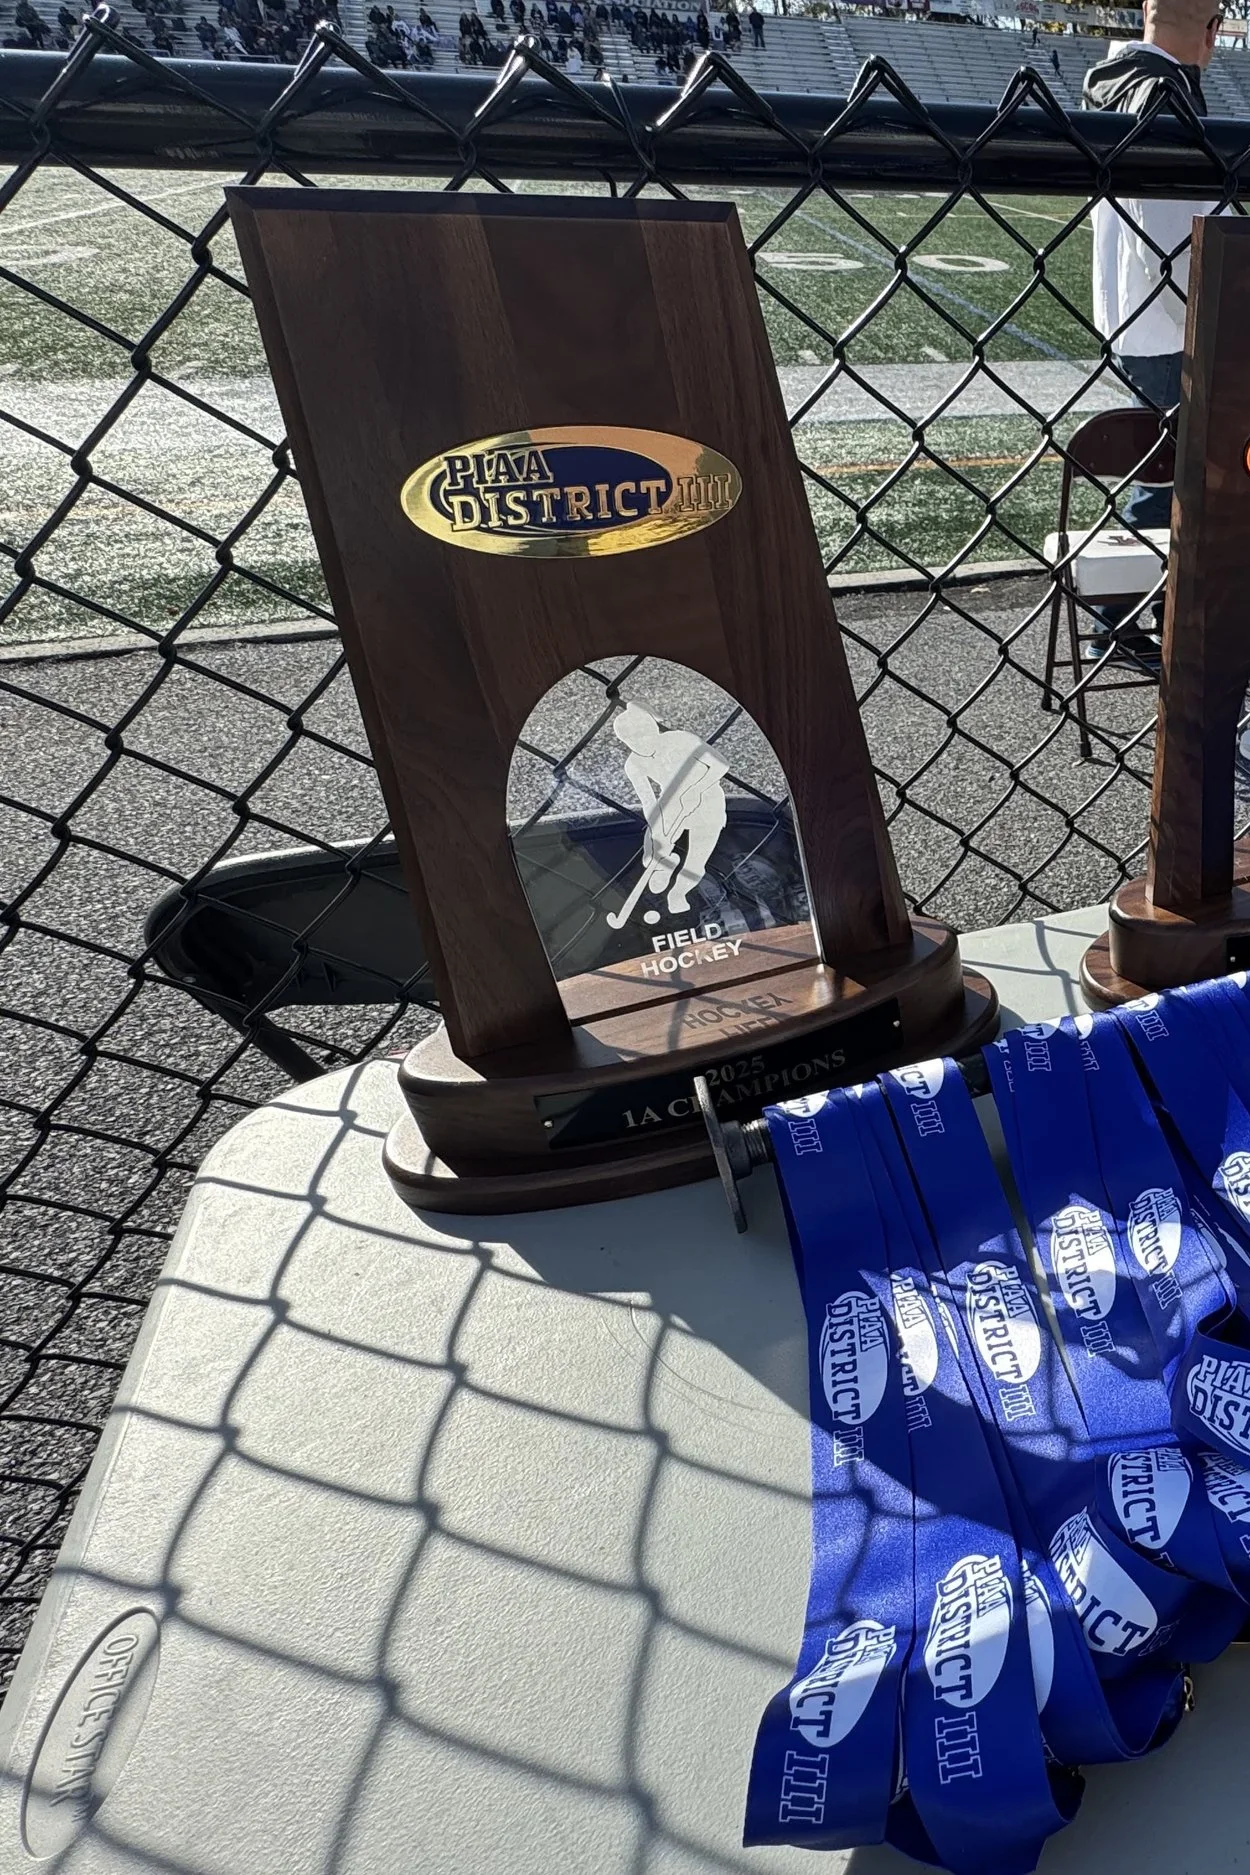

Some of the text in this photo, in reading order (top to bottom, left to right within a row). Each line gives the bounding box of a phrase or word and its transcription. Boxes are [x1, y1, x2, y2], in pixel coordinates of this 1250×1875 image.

[443, 449, 554, 490] PIAA
[449, 473, 732, 532] DISTRICT III
[640, 938, 744, 979] HOCKEY
[651, 922, 723, 954] FIELD
[705, 1055, 766, 1088] 2025
[622, 1106, 662, 1129] 1A
[1082, 1210, 1110, 1257] PIAA
[1128, 1201, 1174, 1278] DISTRICT
[999, 1264, 1031, 1320] PIAA
[1051, 1214, 1117, 1357] DISTRICT III
[855, 1297, 881, 1352] PIAA
[966, 1271, 1037, 1422] DISTRICT III
[826, 1302, 865, 1468] DISTRICT III
[1120, 1452, 1161, 1544] STRICT
[973, 1554, 1007, 1619] PIAA
[78, 1634, 139, 1728] OFFICE
[933, 1564, 983, 1785] DISTRICT III
[778, 1637, 858, 1825] DISTRICT III
[50, 1729, 108, 1807] STAR
